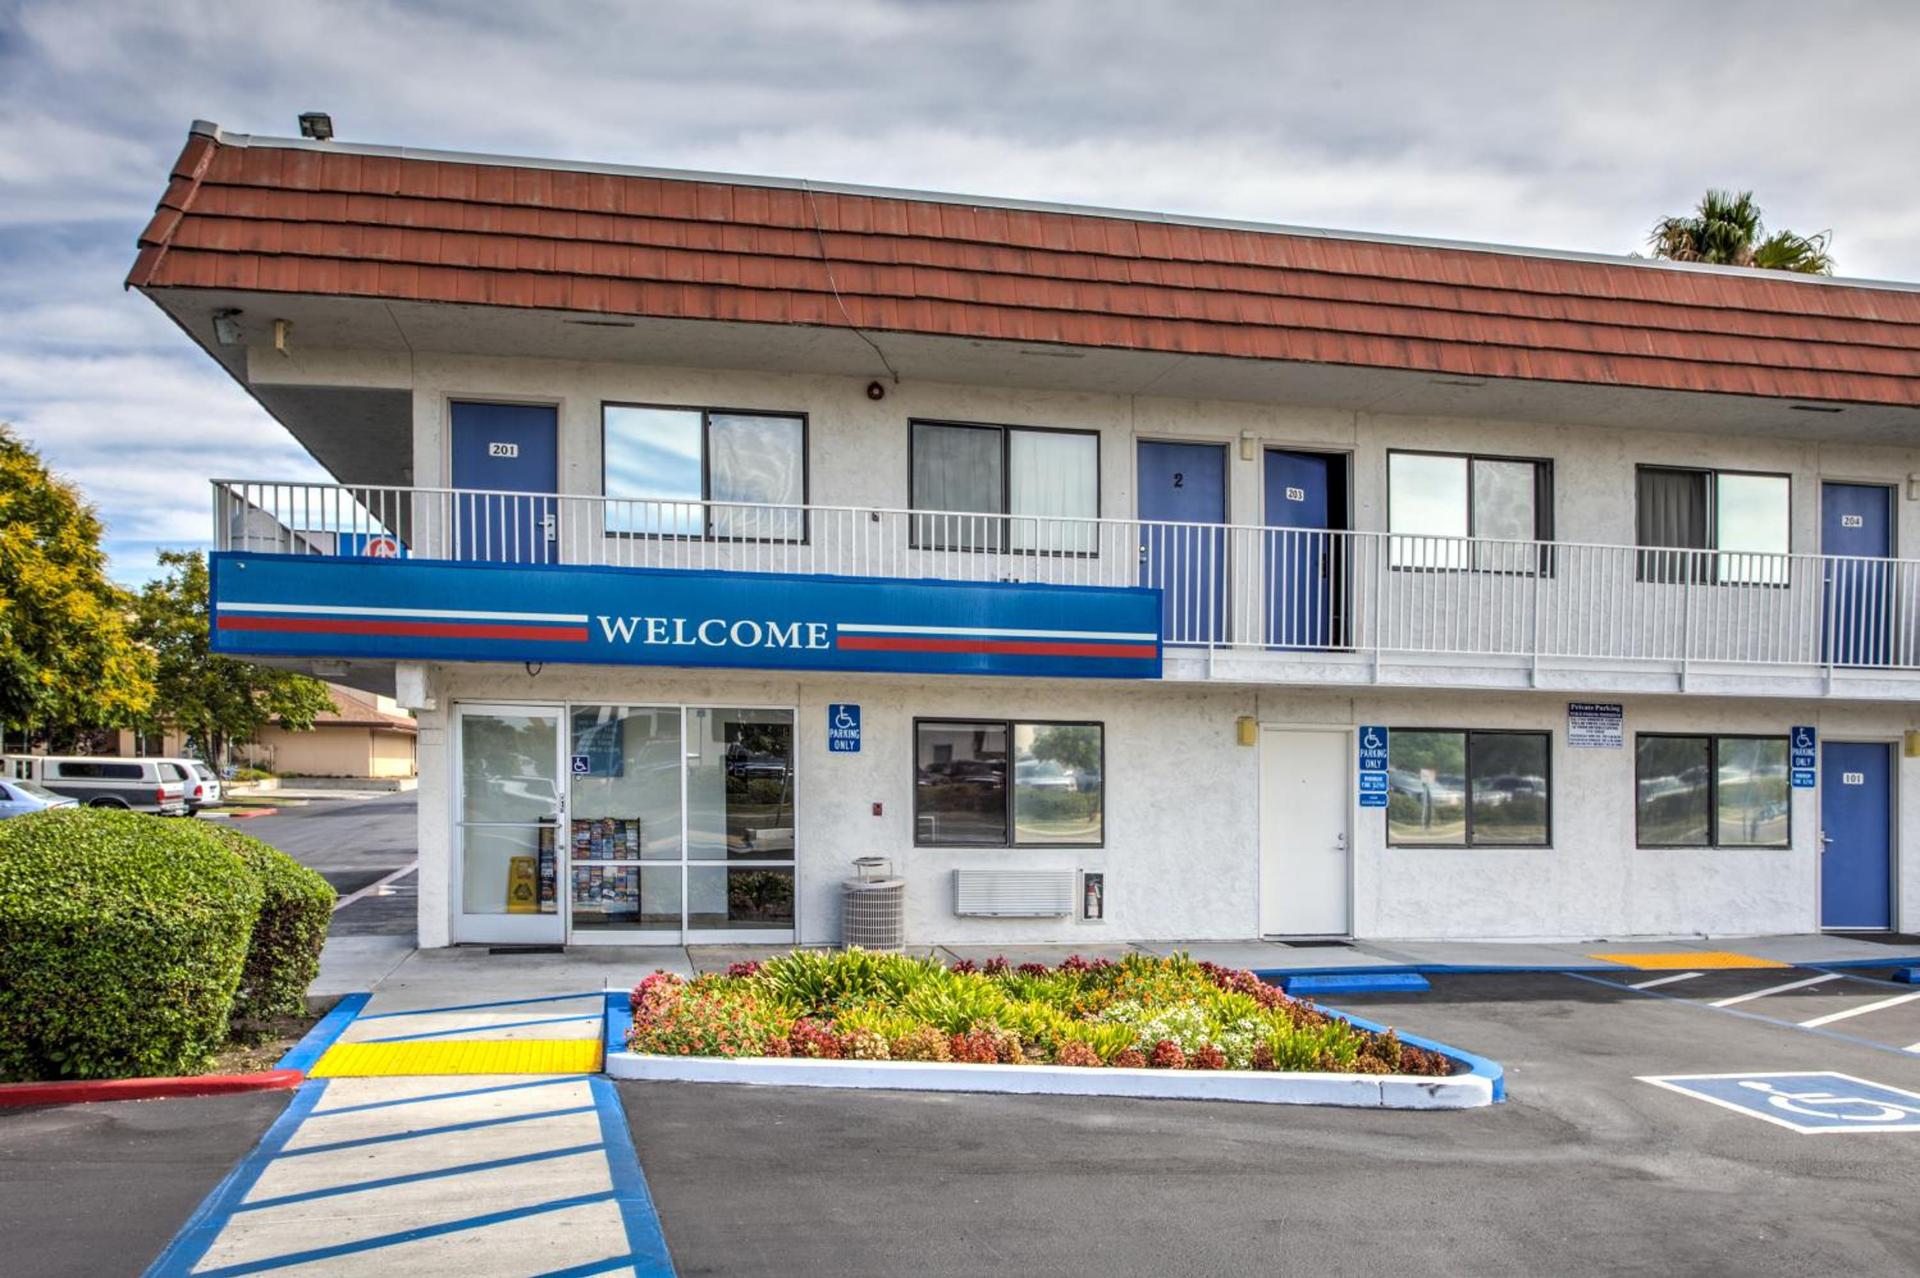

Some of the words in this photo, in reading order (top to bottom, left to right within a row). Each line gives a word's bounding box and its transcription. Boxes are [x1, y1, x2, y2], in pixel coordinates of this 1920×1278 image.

[493, 445, 514, 455] 201
[1174, 473, 1184, 488] 2
[1288, 488, 1303, 499] 203
[597, 615, 830, 649] WELCOME
[829, 729, 860, 739] PARKING
[834, 740, 855, 750] ONLY
[1360, 748, 1387, 758] PARKING
[1792, 748, 1815, 756] PARKING
[1365, 759, 1382, 769] ONLY
[1795, 757, 1811, 766] ONLY
[1846, 774, 1861, 783] 101
